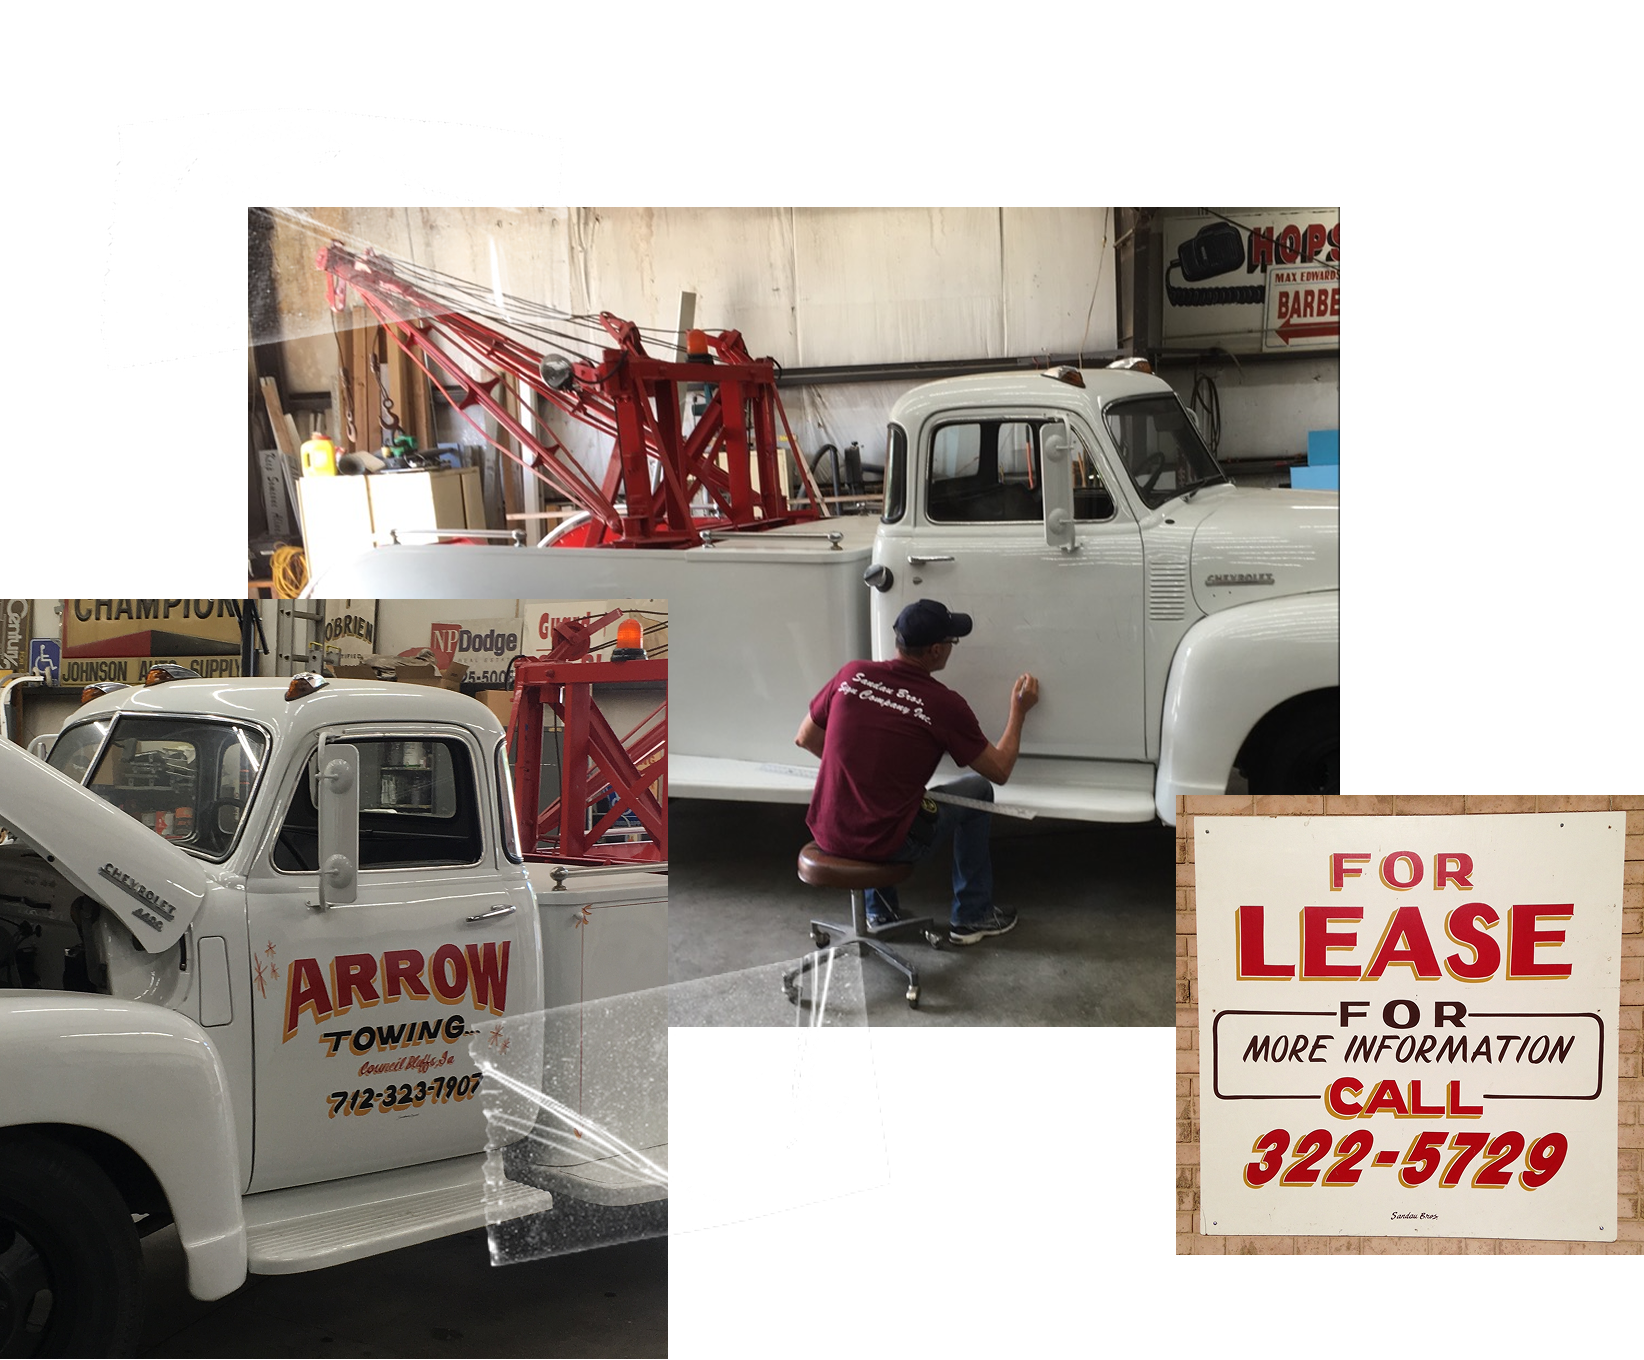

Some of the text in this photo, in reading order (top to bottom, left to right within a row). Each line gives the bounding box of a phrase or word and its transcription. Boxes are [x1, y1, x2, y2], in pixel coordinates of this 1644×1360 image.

[1275, 272, 1298, 284] MAX
[1206, 573, 1274, 582] CHEVROLET
[3, 599, 28, 667] Century
[433, 629, 518, 657] NP Dodge
[62, 660, 128, 681] JOHNSON
[851, 672, 895, 696] Sandau
[858, 689, 911, 716] Company
[913, 707, 933, 726] Inc.
[104, 862, 177, 916] CHEVROLET
[1329, 850, 1476, 892] FOR
[1234, 902, 1576, 983] LEASE
[281, 940, 512, 1045] ARROW
[1339, 999, 1468, 1030] FOR
[358, 1056, 407, 1077] Council
[1242, 1034, 1576, 1065] MORE INFORMATION
[325, 1072, 484, 1119] 712-323-7907
[1324, 1076, 1485, 1120] CALL
[1242, 1128, 1569, 1192] 322-5729
